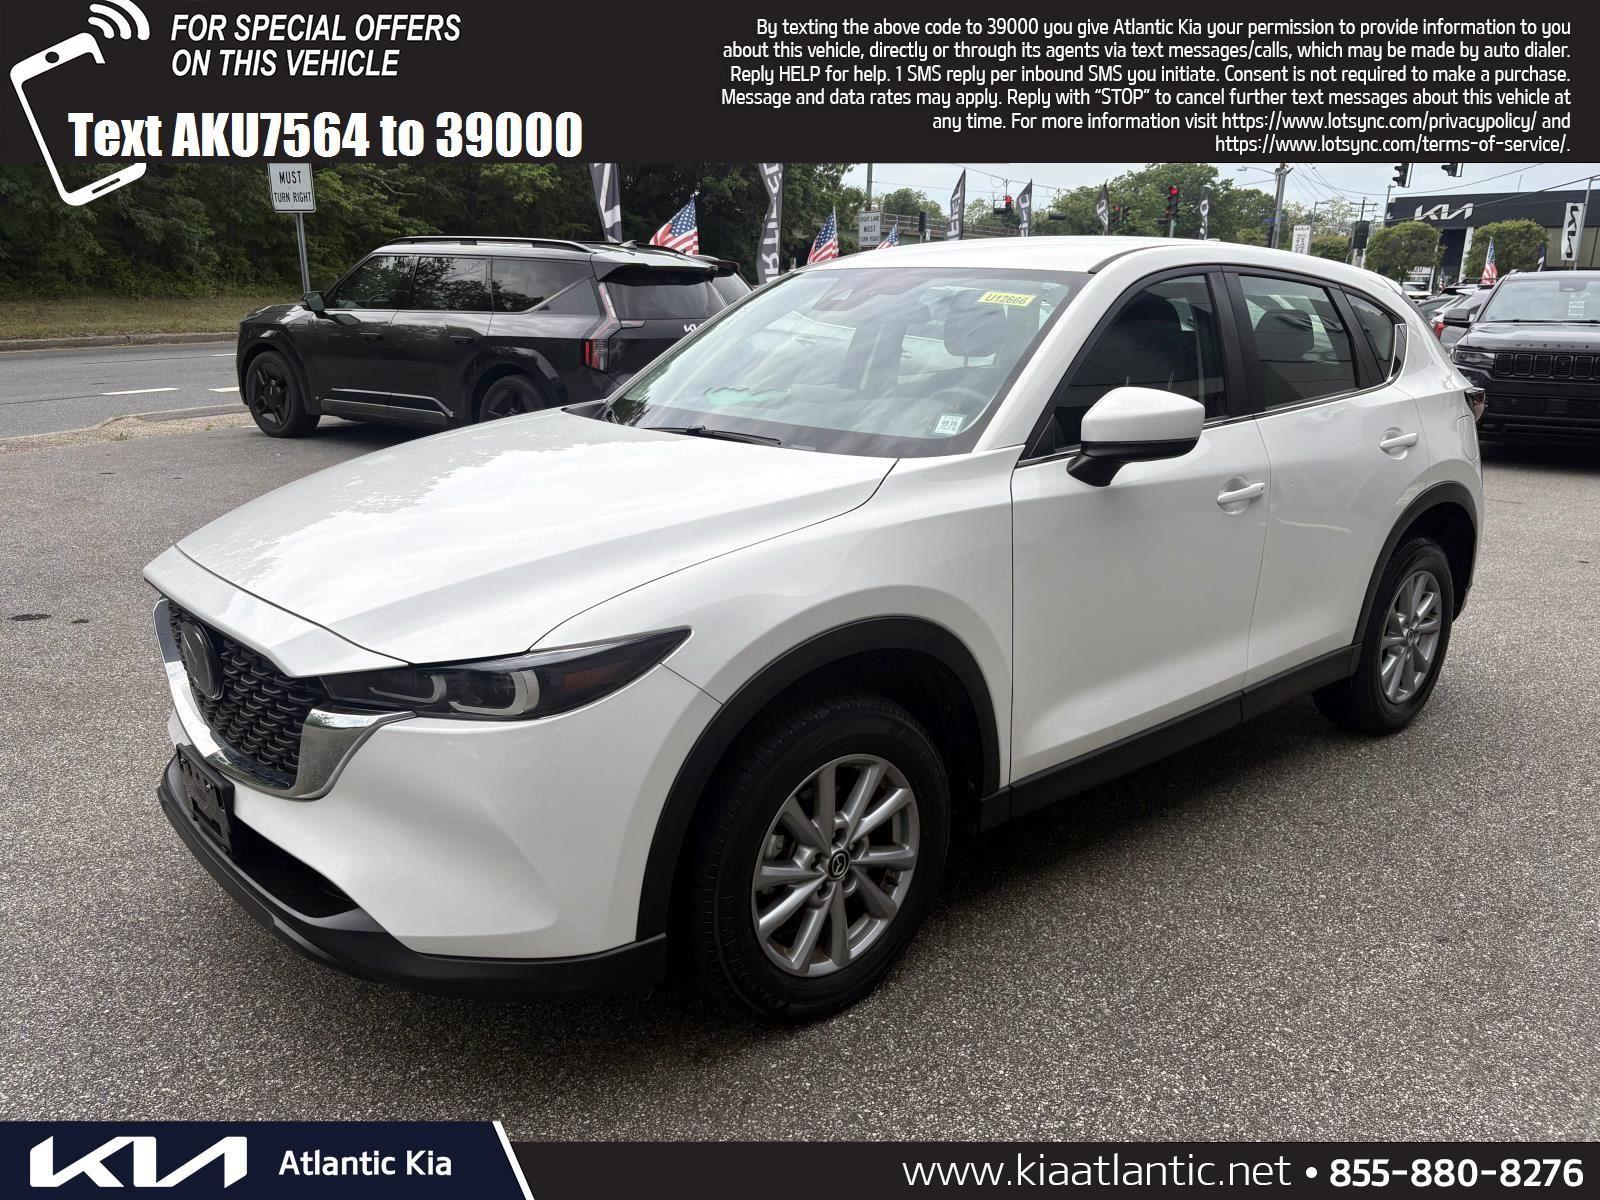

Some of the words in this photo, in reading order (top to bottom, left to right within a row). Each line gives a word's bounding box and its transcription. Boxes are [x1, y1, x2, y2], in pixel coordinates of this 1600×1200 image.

[278, 171, 302, 184] MUST
[273, 192, 291, 203] TURN
[293, 192, 312, 203] RIGHT
[863, 225, 876, 233] MUST
